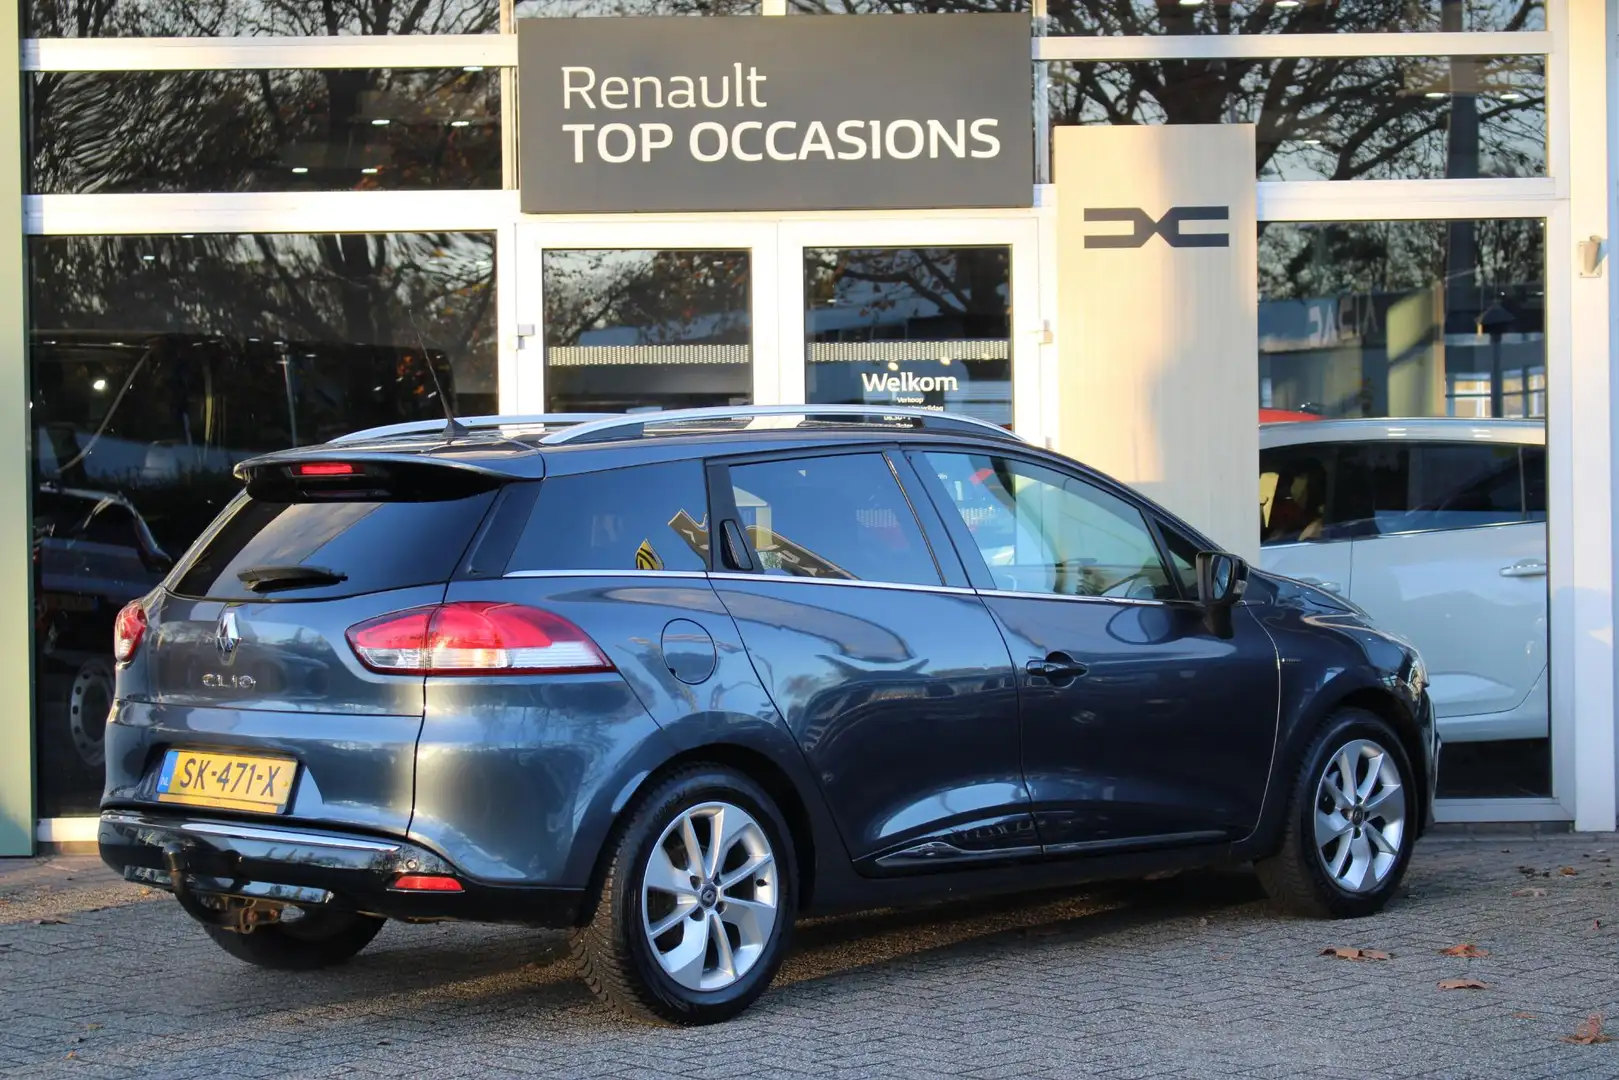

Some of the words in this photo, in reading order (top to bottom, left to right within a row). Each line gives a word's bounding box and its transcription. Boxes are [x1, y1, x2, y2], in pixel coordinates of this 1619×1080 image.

[561, 62, 767, 109] Renault
[562, 122, 674, 164] TOP
[690, 117, 1001, 163] OCCASIONS
[862, 372, 959, 392] Welkom
[896, 396, 924, 404] Verkoop
[202, 673, 256, 688] CLIO
[180, 758, 281, 797] SK-471-X
